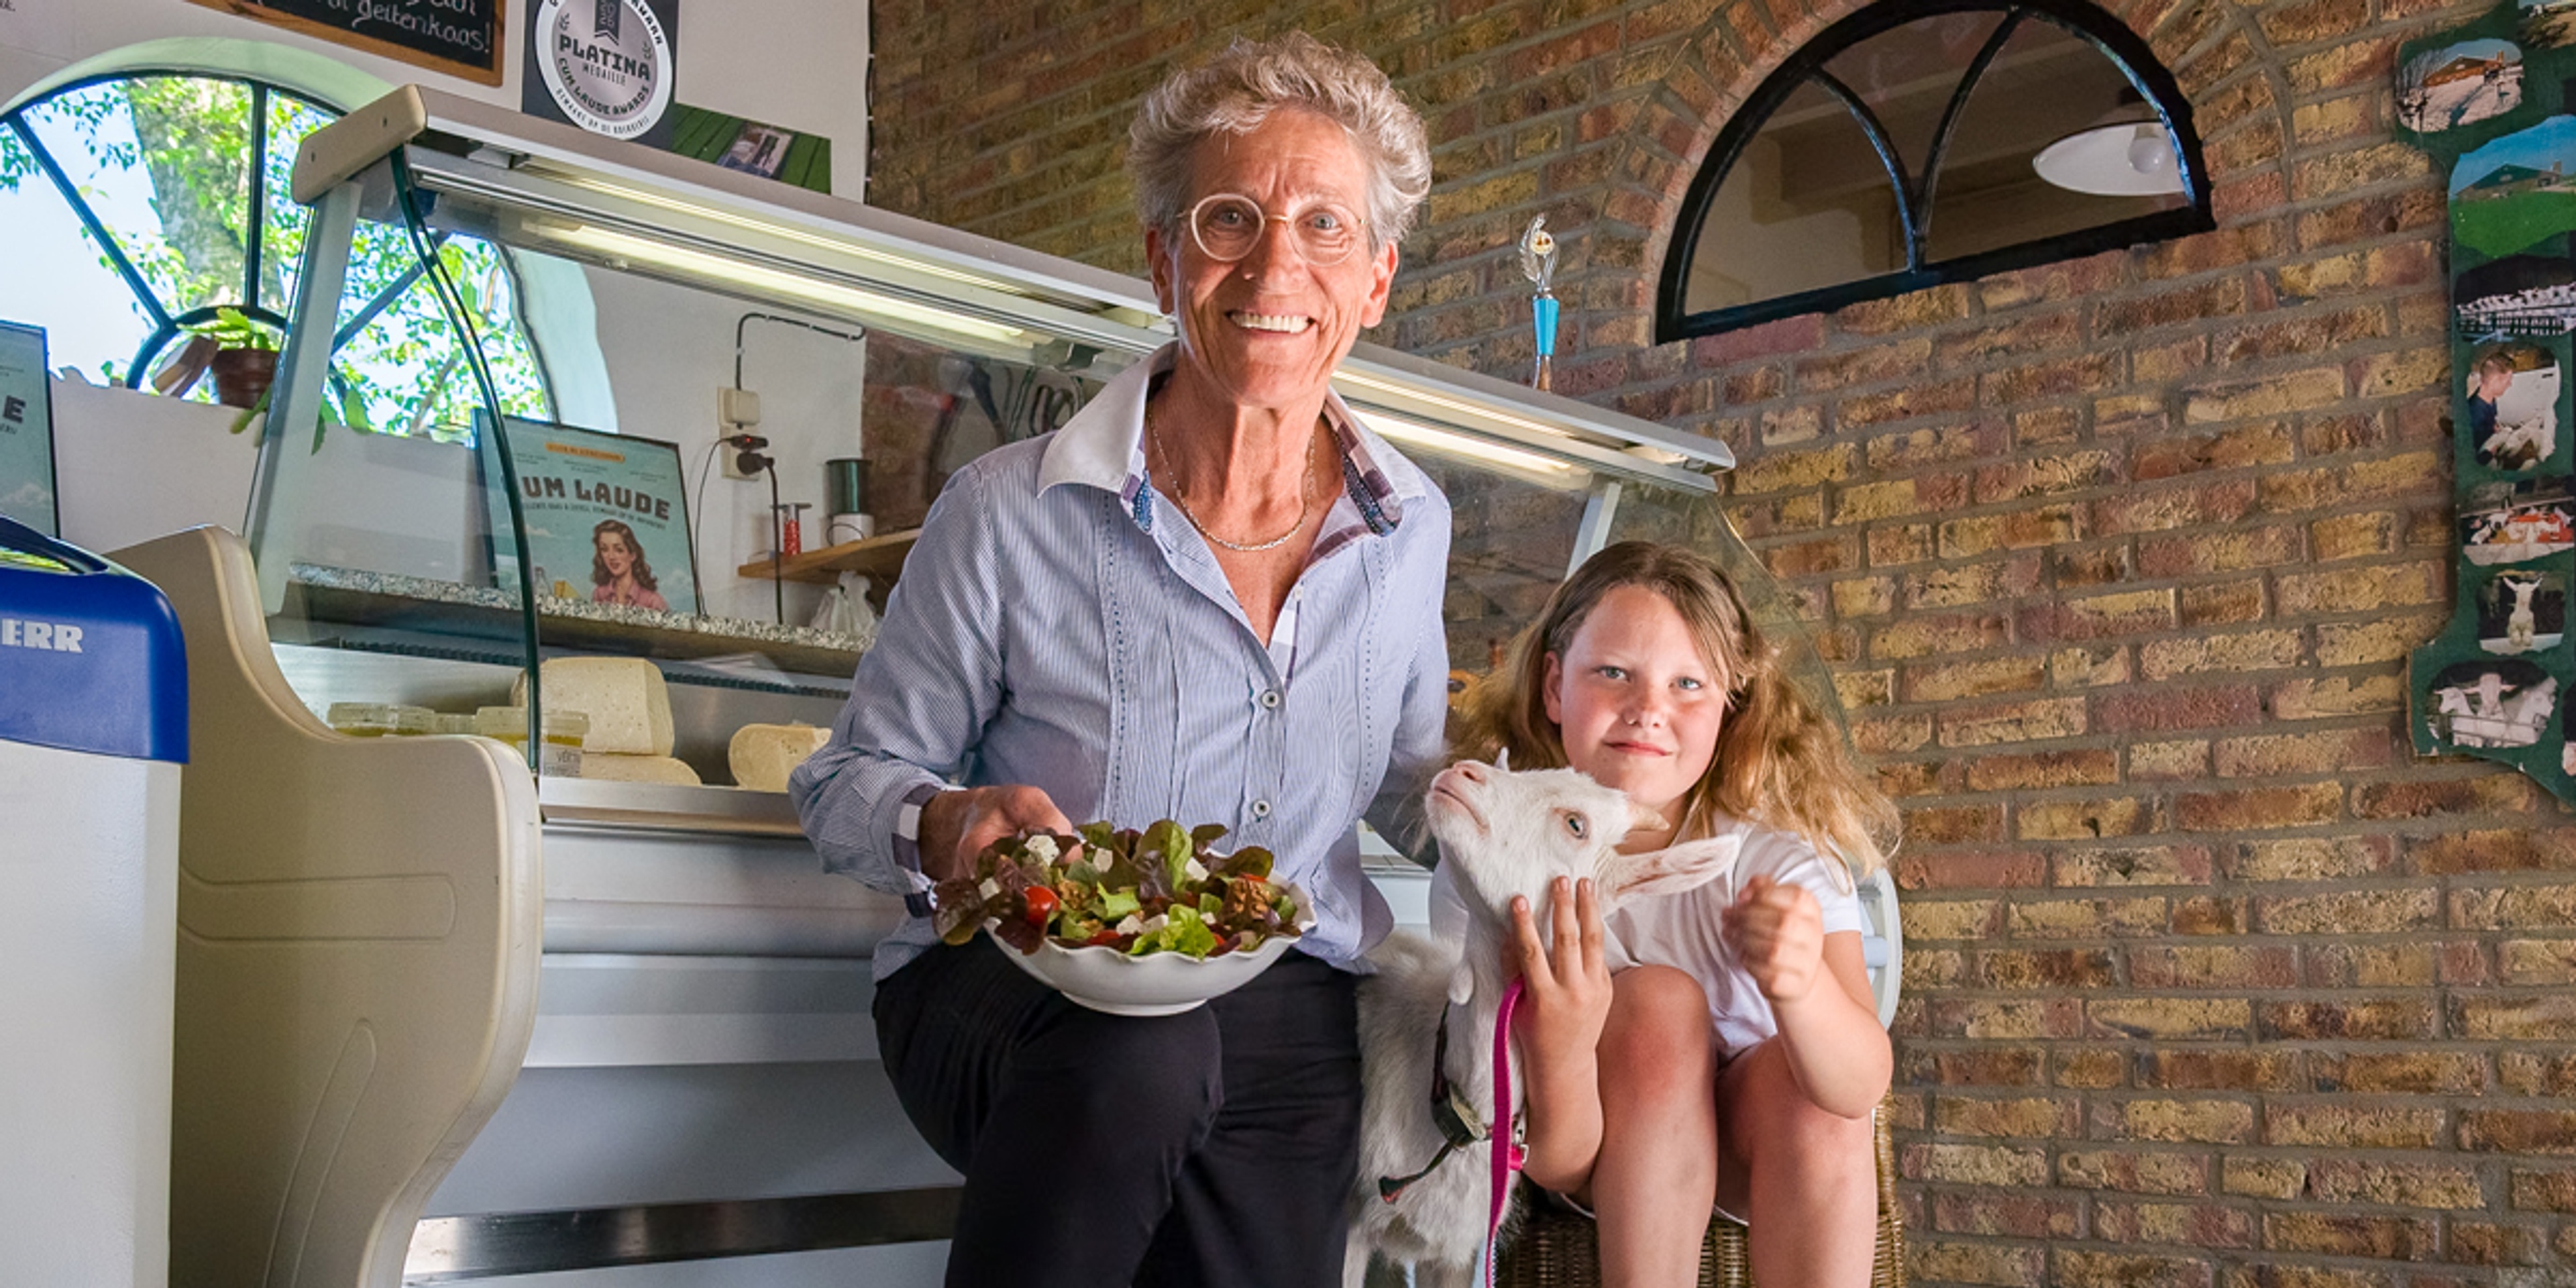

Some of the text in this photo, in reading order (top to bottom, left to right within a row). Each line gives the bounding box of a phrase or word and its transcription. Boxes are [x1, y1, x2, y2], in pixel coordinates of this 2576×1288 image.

[352, 0, 490, 54] geitenkaas!
[559, 34, 651, 81] PLATINA
[582, 64, 626, 86] MEDAILLE
[558, 57, 650, 115] CUM LAUDE AWARDS
[523, 476, 566, 498] UM
[574, 479, 670, 521] LAUDE
[2, 618, 83, 653] ERR
